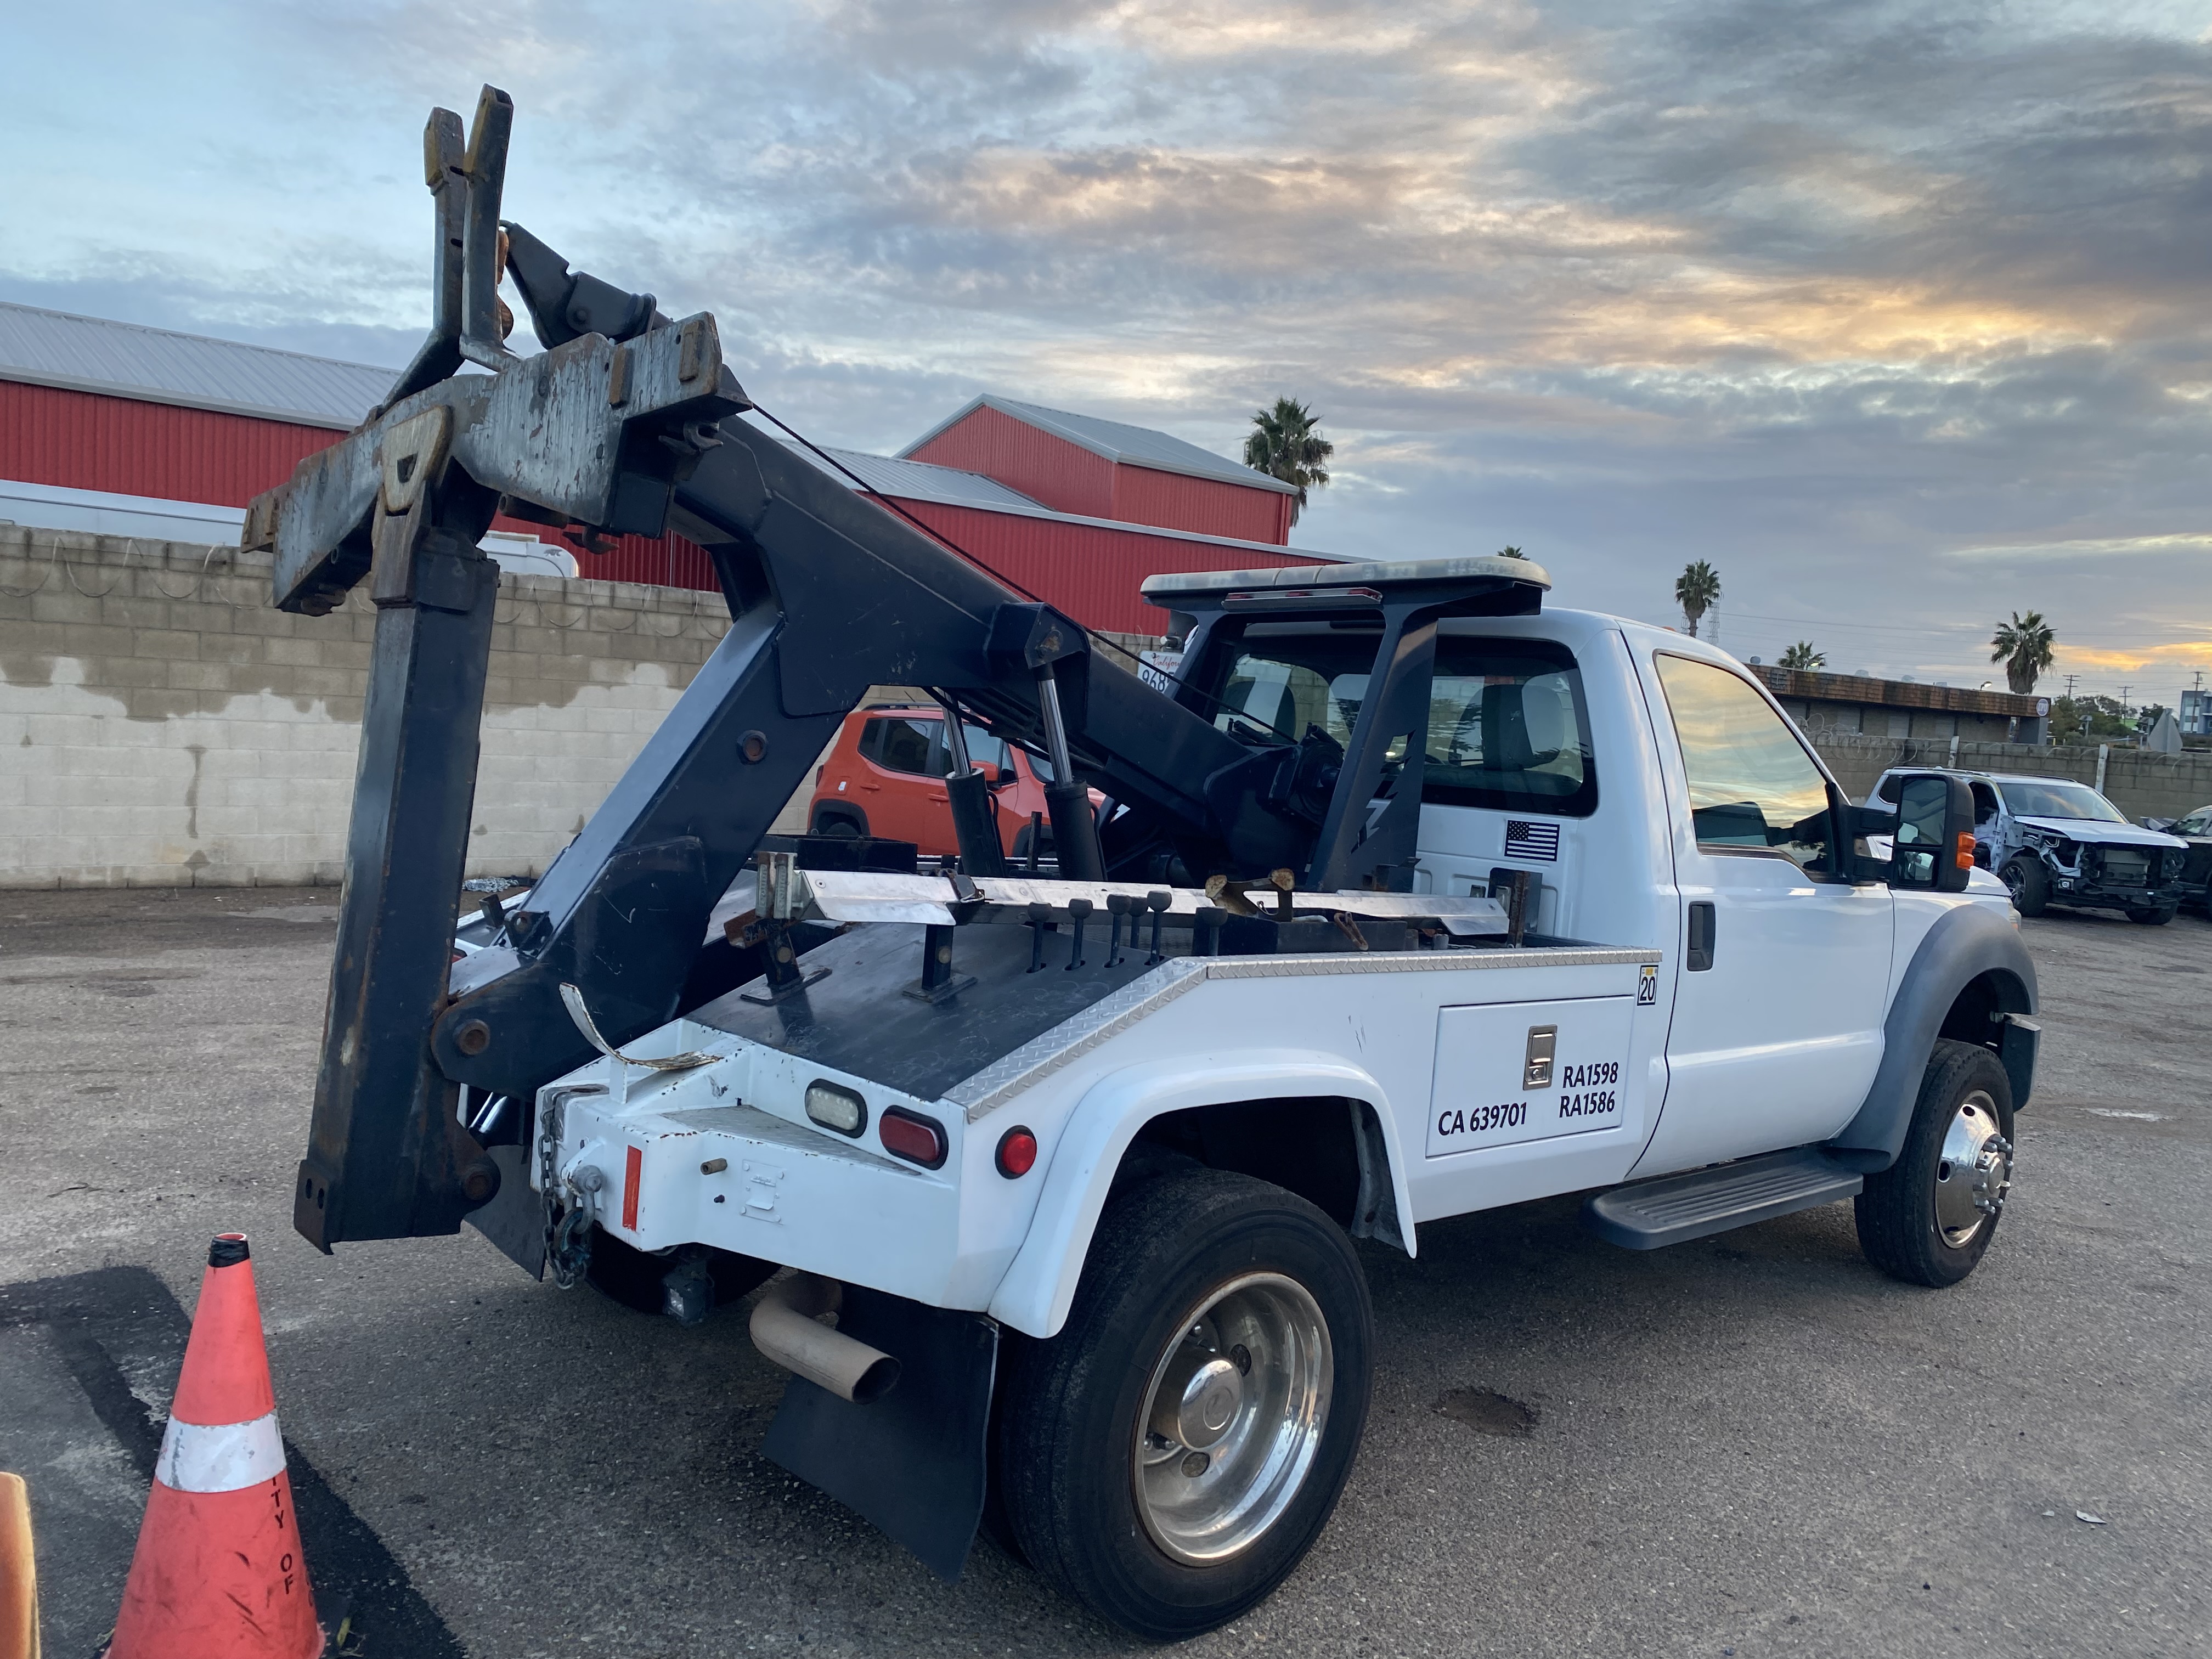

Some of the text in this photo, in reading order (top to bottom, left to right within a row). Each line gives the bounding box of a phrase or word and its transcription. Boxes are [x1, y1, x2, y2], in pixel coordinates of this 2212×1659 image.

[1640, 977, 1655, 1001] 20
[1563, 1062, 1618, 1088] RA1598
[1559, 1091, 1615, 1118] RA1586
[1438, 1102, 1527, 1136] CA 639701
[280, 1553, 294, 1594] OF
